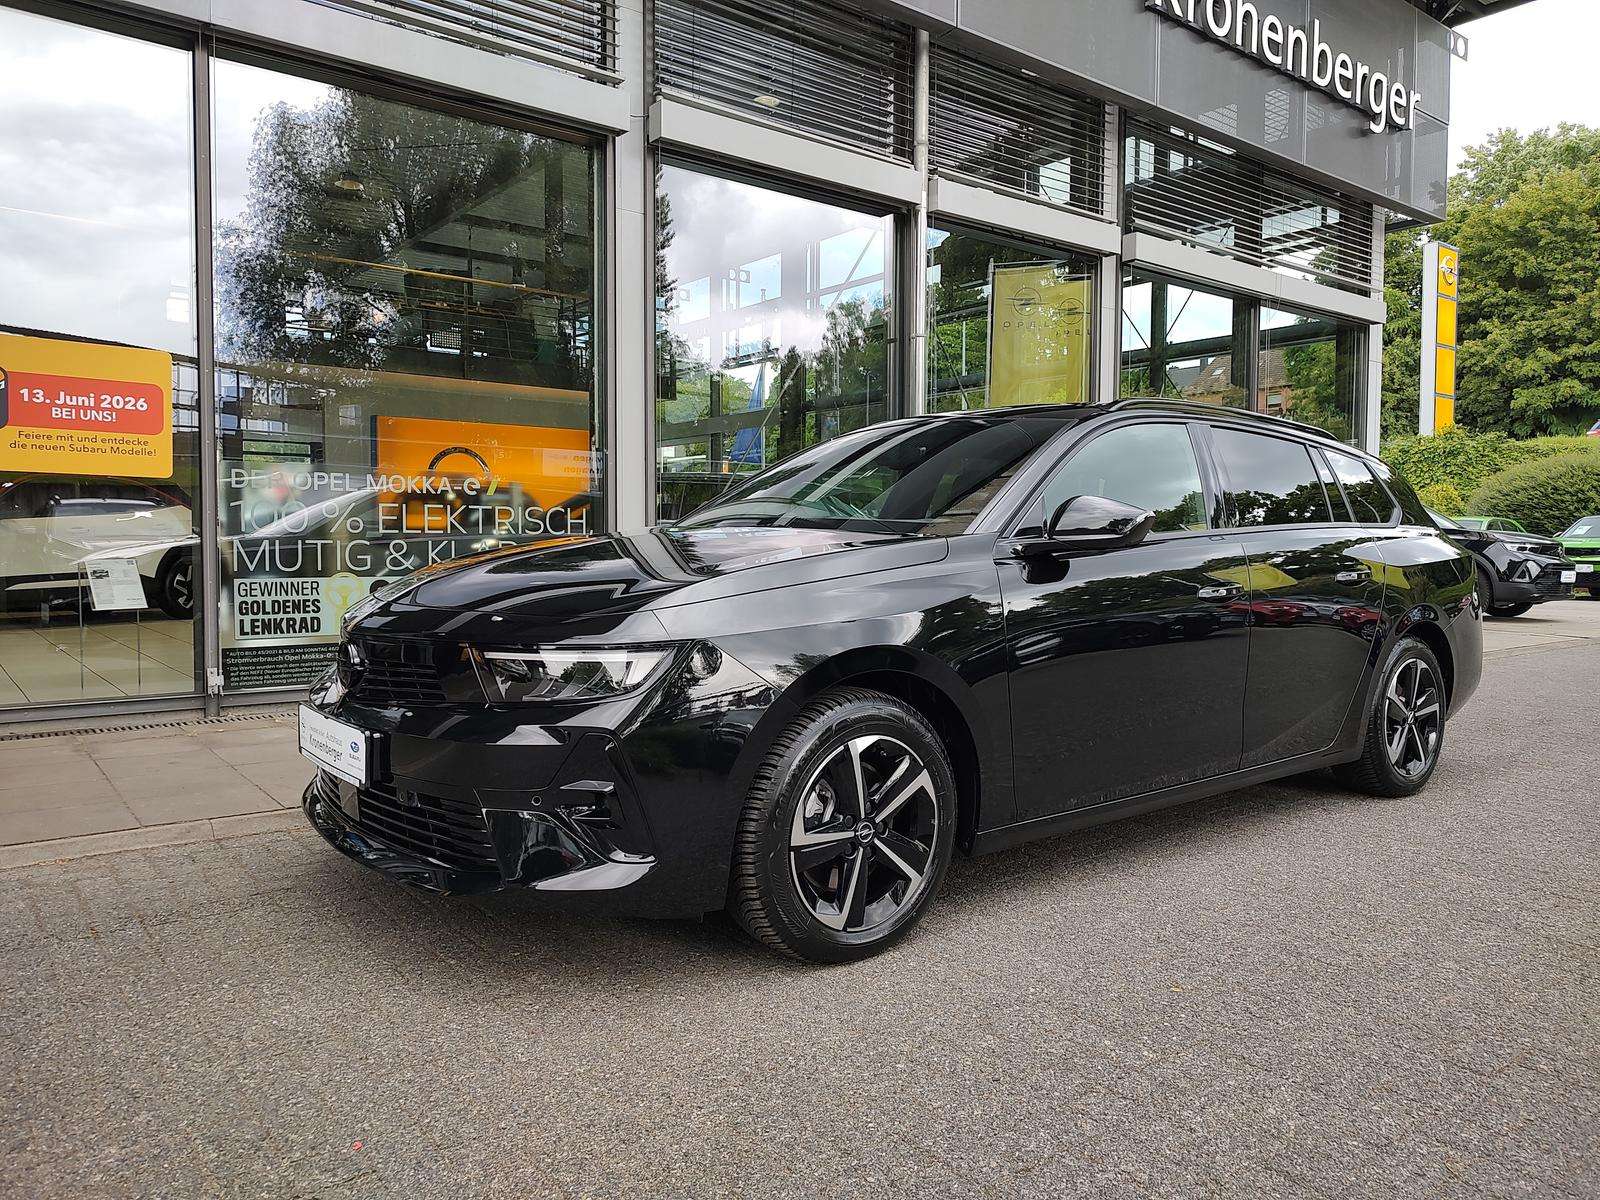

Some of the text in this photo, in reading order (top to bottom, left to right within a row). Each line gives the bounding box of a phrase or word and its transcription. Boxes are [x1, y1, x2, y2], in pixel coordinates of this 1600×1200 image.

[19, 388, 148, 411] 13. Juni 2026
[51, 406, 117, 422] BEI UNS!
[18, 430, 149, 447] Feiere mit und entdecke
[9, 440, 157, 457] die neuen Subaru Modelle!
[289, 471, 358, 492] OPEL
[366, 473, 481, 497] MOKKA-e
[230, 500, 594, 537] 100 % ELEKTRISCH,
[233, 539, 372, 572] MUTIG
[386, 539, 415, 571] &
[238, 580, 320, 597] GEWINNER
[238, 599, 321, 616] GOLDENES
[240, 617, 321, 636] LENKRAD
